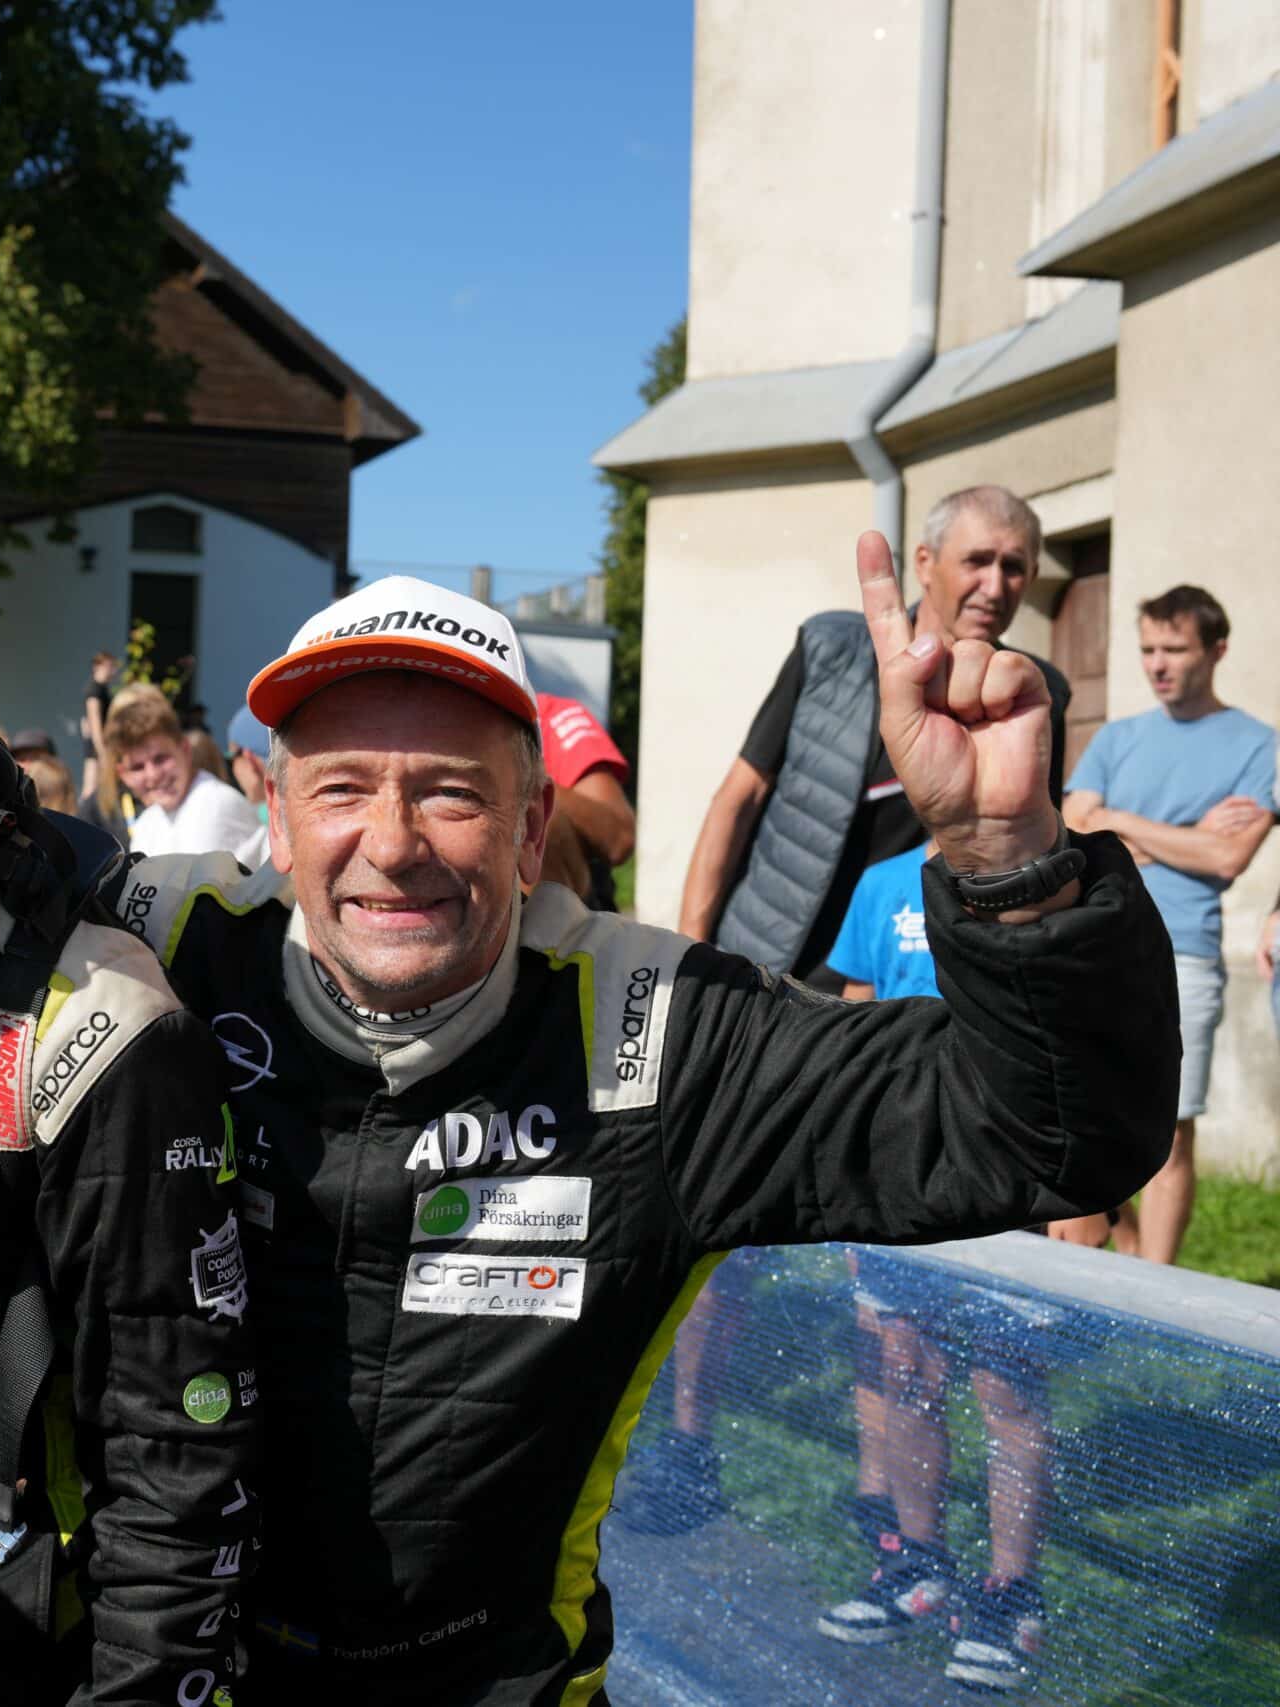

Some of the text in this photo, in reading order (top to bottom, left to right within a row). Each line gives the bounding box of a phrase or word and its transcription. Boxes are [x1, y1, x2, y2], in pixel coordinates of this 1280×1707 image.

[616, 967, 652, 1082] sparco
[32, 1011, 111, 1113] sparco
[173, 1136, 202, 1149] CORSA
[404, 1104, 557, 1171] ADAC
[479, 1188, 517, 1205] Dina
[423, 1202, 464, 1221] dina
[479, 1208, 583, 1230] Försäkringar
[188, 1387, 228, 1407] dina
[417, 1607, 488, 1648] Carlberg
